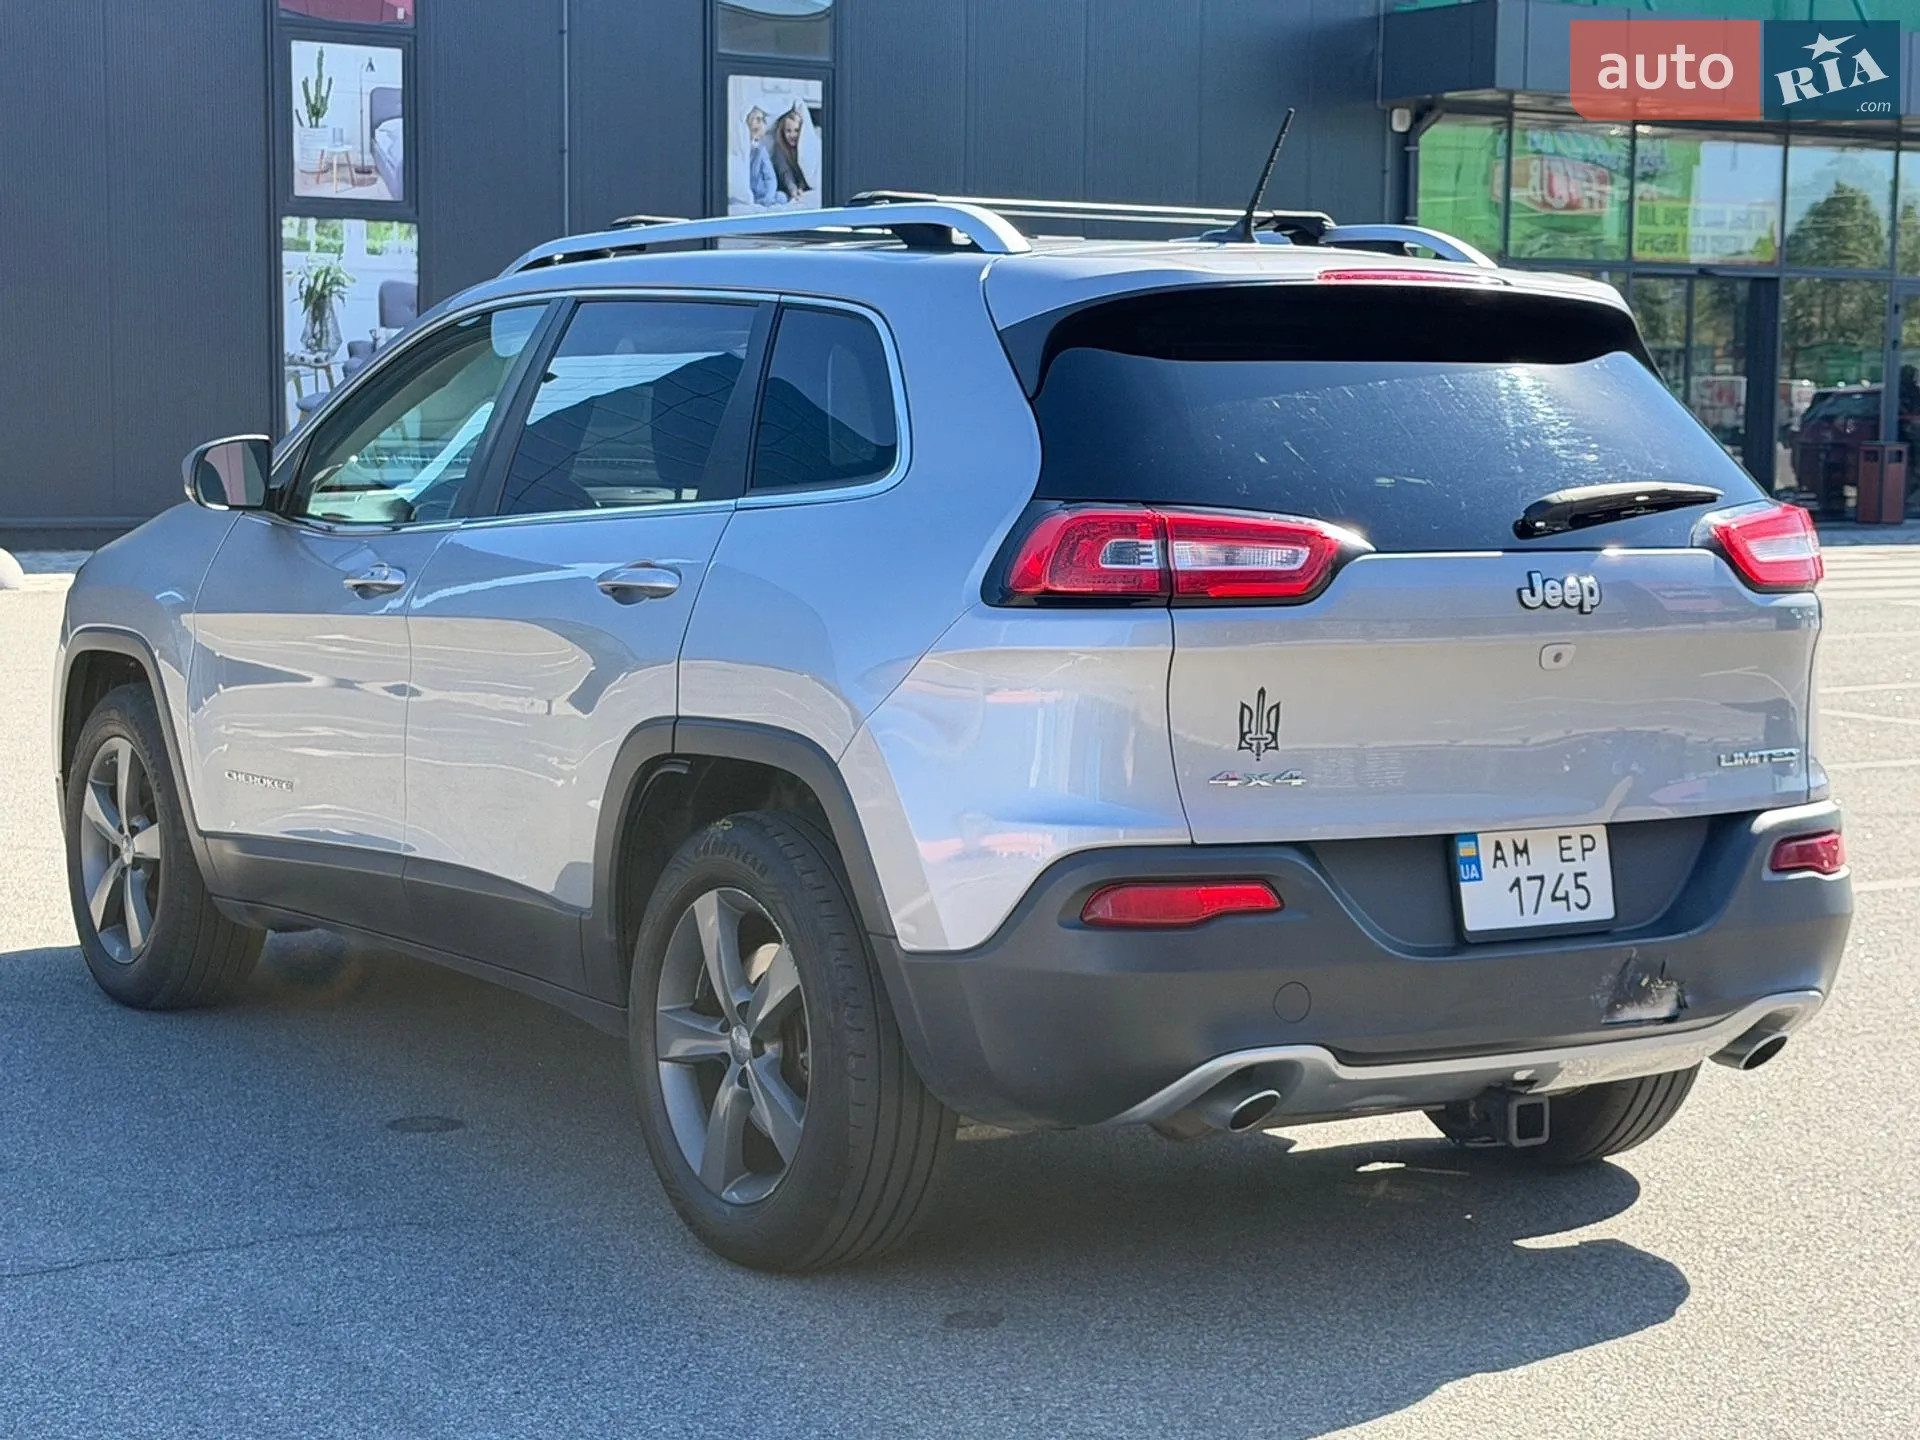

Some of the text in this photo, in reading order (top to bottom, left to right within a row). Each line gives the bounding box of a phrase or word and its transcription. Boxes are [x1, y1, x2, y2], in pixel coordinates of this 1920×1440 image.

[1518, 570, 1602, 614] Jeep
[1719, 747, 1800, 768] LIMITED
[224, 769, 294, 792] CHEROKEE
[1492, 834, 1596, 868] AM EP
[1460, 864, 1480, 881] UA
[1508, 871, 1592, 916] 1745
